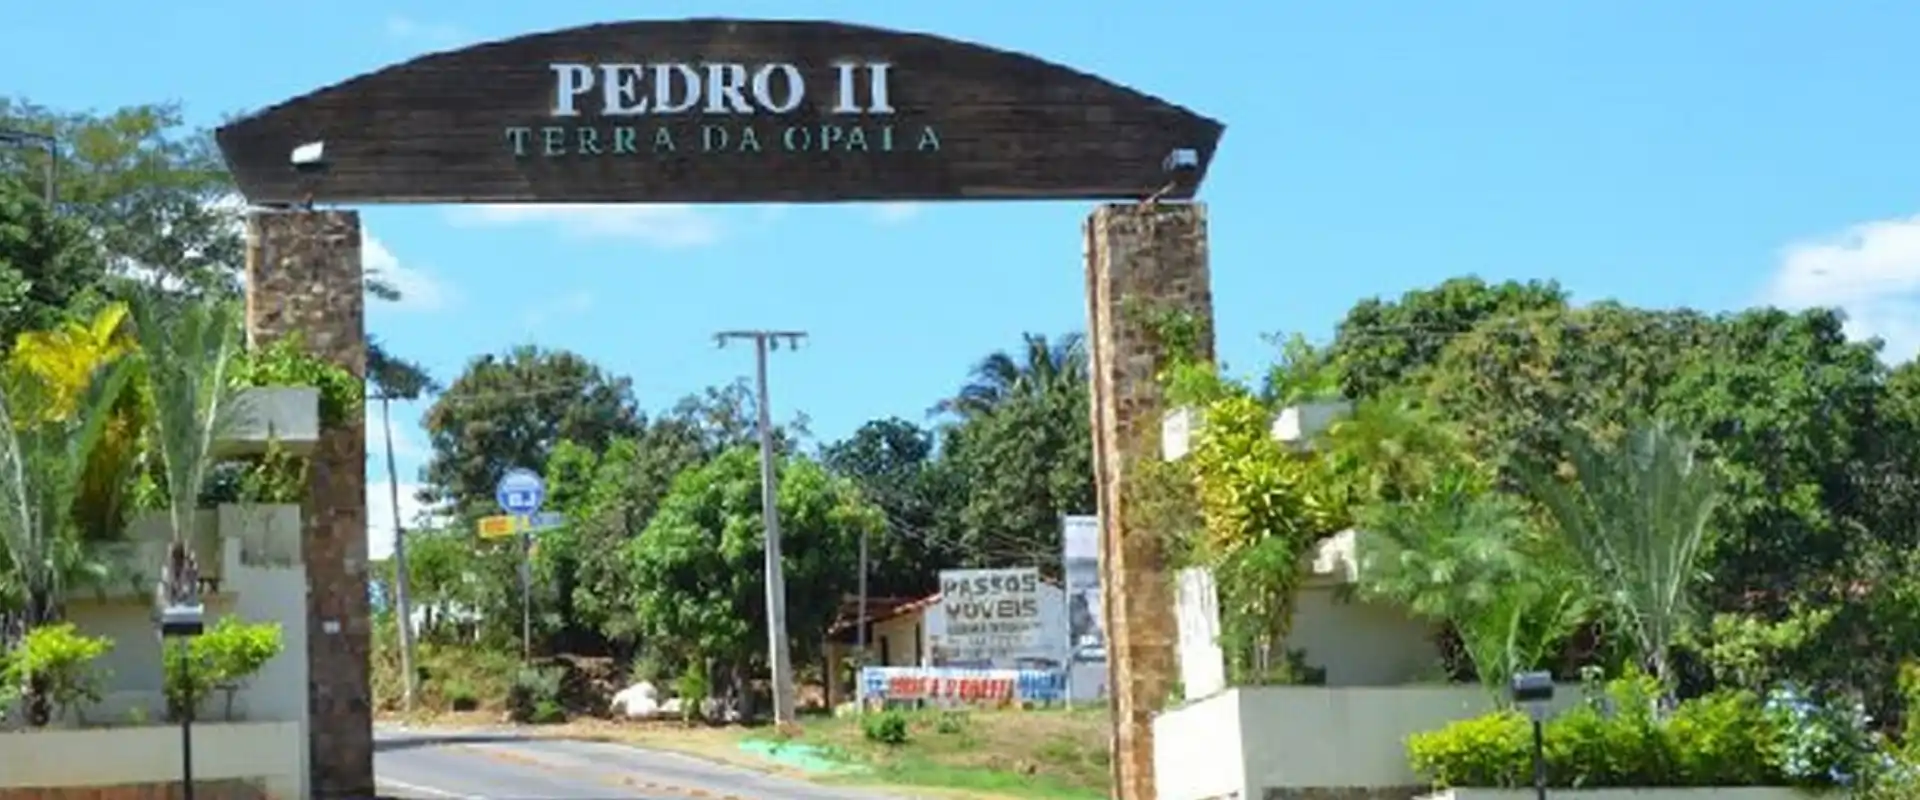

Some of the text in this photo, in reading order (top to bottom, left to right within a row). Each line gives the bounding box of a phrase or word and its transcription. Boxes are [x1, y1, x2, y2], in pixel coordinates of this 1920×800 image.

[549, 62, 895, 117] PEDRO II
[506, 125, 676, 156] TERRA
[702, 125, 762, 153] DA
[943, 574, 1036, 598] PASSOS
